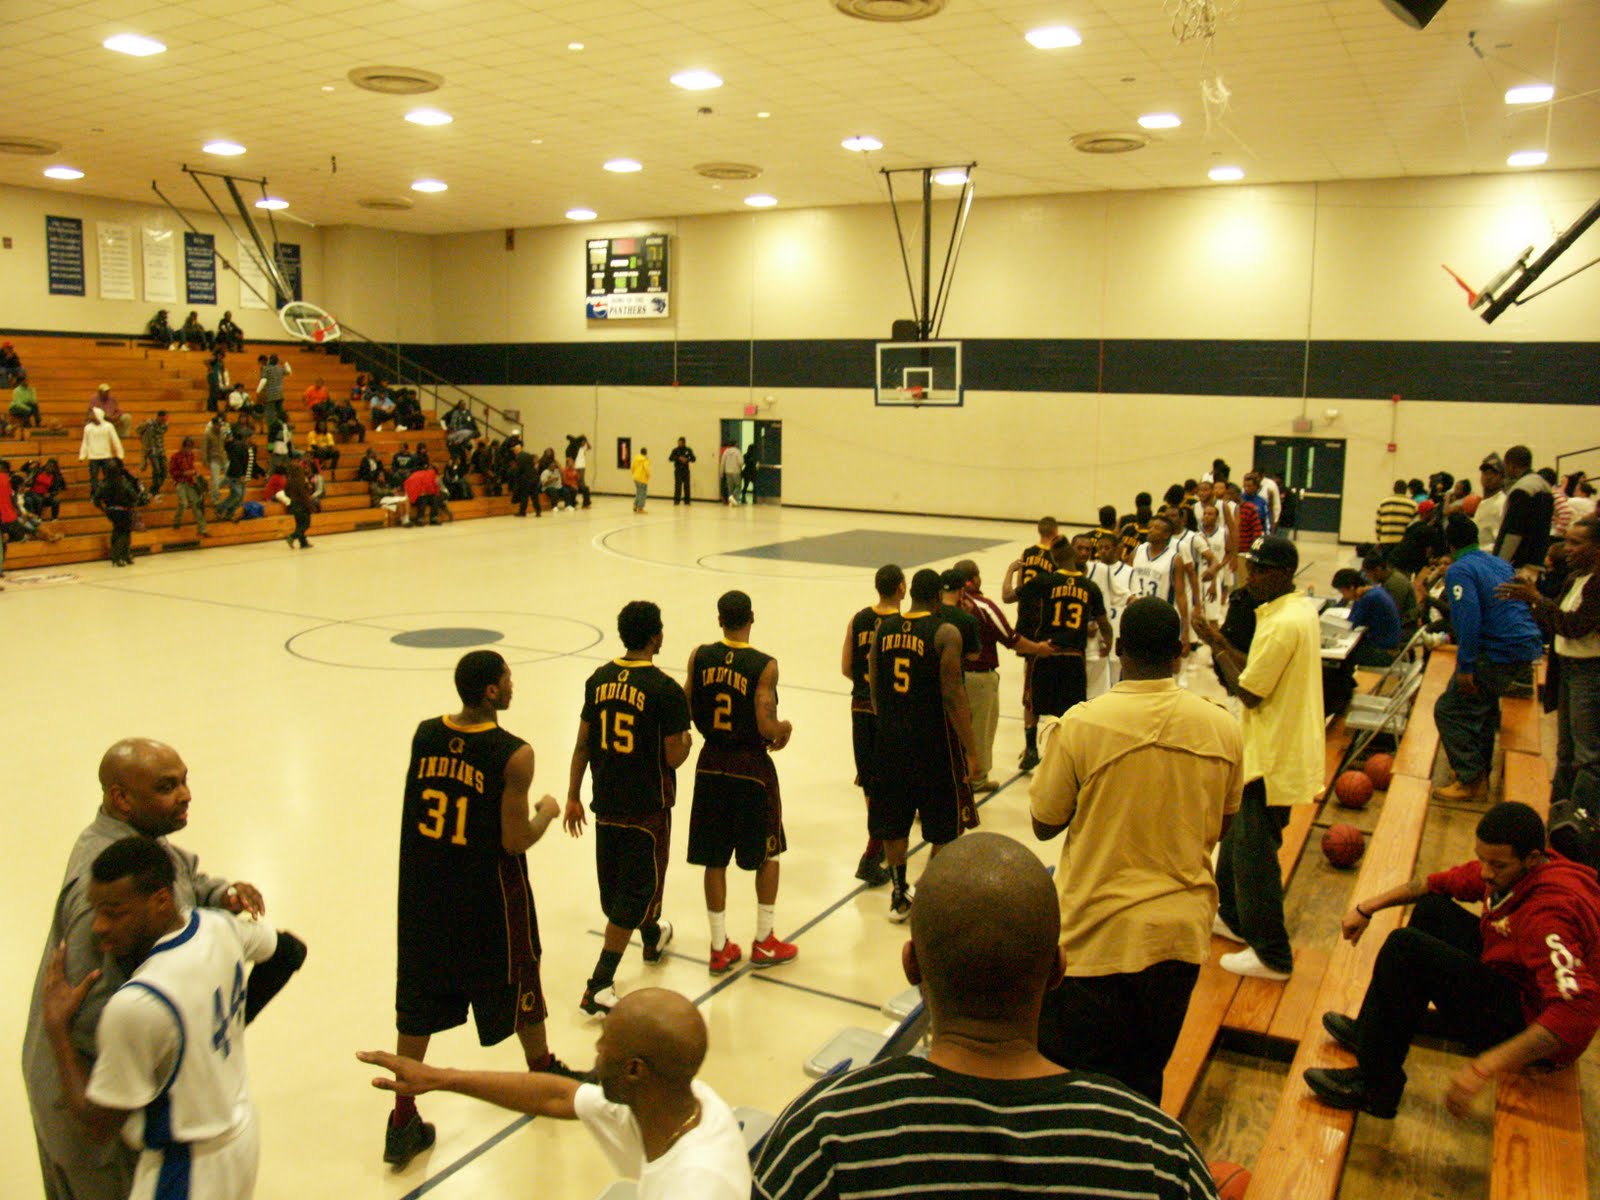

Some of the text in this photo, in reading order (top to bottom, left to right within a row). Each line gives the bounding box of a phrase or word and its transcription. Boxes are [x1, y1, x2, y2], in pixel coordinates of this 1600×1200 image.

[1051, 585, 1089, 604] INDIANS
[1452, 584, 1463, 601] 9
[1051, 601, 1083, 630] 13
[882, 633, 924, 657] INDIANS
[894, 657, 910, 693] 5
[595, 682, 645, 713] INDIANS
[714, 691, 732, 731] 2
[600, 709, 634, 754] 15
[418, 756, 485, 795] INDIANS
[418, 788, 468, 846] 31
